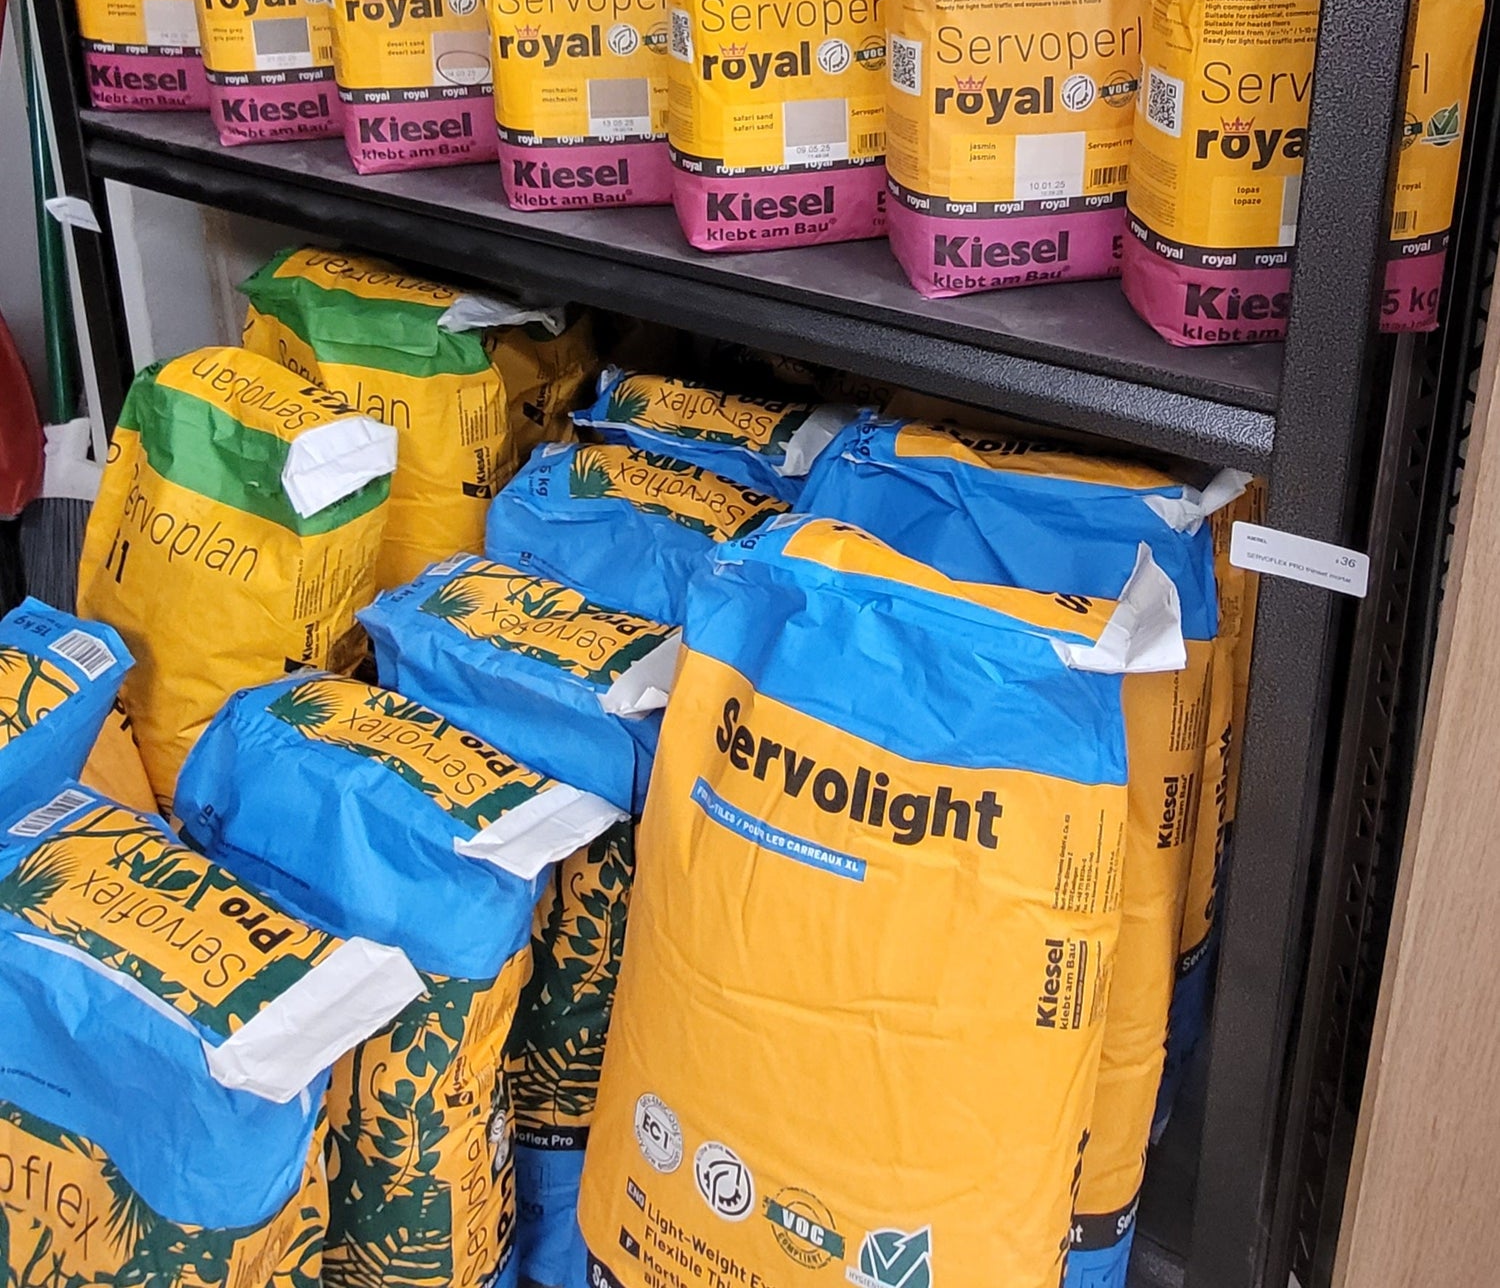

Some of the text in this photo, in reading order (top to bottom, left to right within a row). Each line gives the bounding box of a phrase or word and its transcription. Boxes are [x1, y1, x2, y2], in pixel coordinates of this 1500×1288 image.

[499, 25, 601, 67] royal
[936, 16, 1142, 70] Servoperl
[90, 65, 187, 92] Kiesel
[702, 41, 810, 89] royal
[934, 76, 1054, 125] royal
[1108, 82, 1131, 95] VOC
[221, 95, 330, 123] Kiesel
[733, 114, 755, 122] safari
[733, 123, 755, 132] safari
[359, 113, 473, 144] Kiesel
[969, 142, 996, 151] jasmin
[1088, 139, 1122, 150] Servoperl
[514, 158, 629, 189] Kiesel
[969, 153, 996, 162] jasmin
[706, 185, 834, 222] Kiesel
[946, 194, 1113, 214] royal royal royal royal
[934, 230, 1070, 269] Kiesel
[1156, 241, 1287, 266] royal royal royal
[1403, 240, 1431, 254] royal
[1380, 290, 1400, 315] 5
[655, 387, 773, 437] Servoflex
[614, 462, 746, 526] Servoflex
[1289, 562, 1304, 571] PRO
[339, 707, 487, 798] Servoflex
[460, 734, 518, 779] Pro
[714, 696, 1004, 850] Servolight
[1157, 776, 1179, 849] Kiesel
[766, 833, 785, 847] LES
[787, 841, 842, 867] CARREAUX
[844, 860, 858, 872] XL
[69, 869, 247, 989] Servoflex
[218, 896, 295, 953] Pro
[1036, 939, 1064, 1028] Kiesel
[1060, 973, 1074, 1030] klebt am
[551, 1133, 574, 1147] Pro
[648, 1203, 747, 1281] Light-Weight
[782, 1209, 825, 1246] VOC
[645, 1226, 702, 1277] Flexible
[777, 1232, 821, 1263] COMPLIANT
